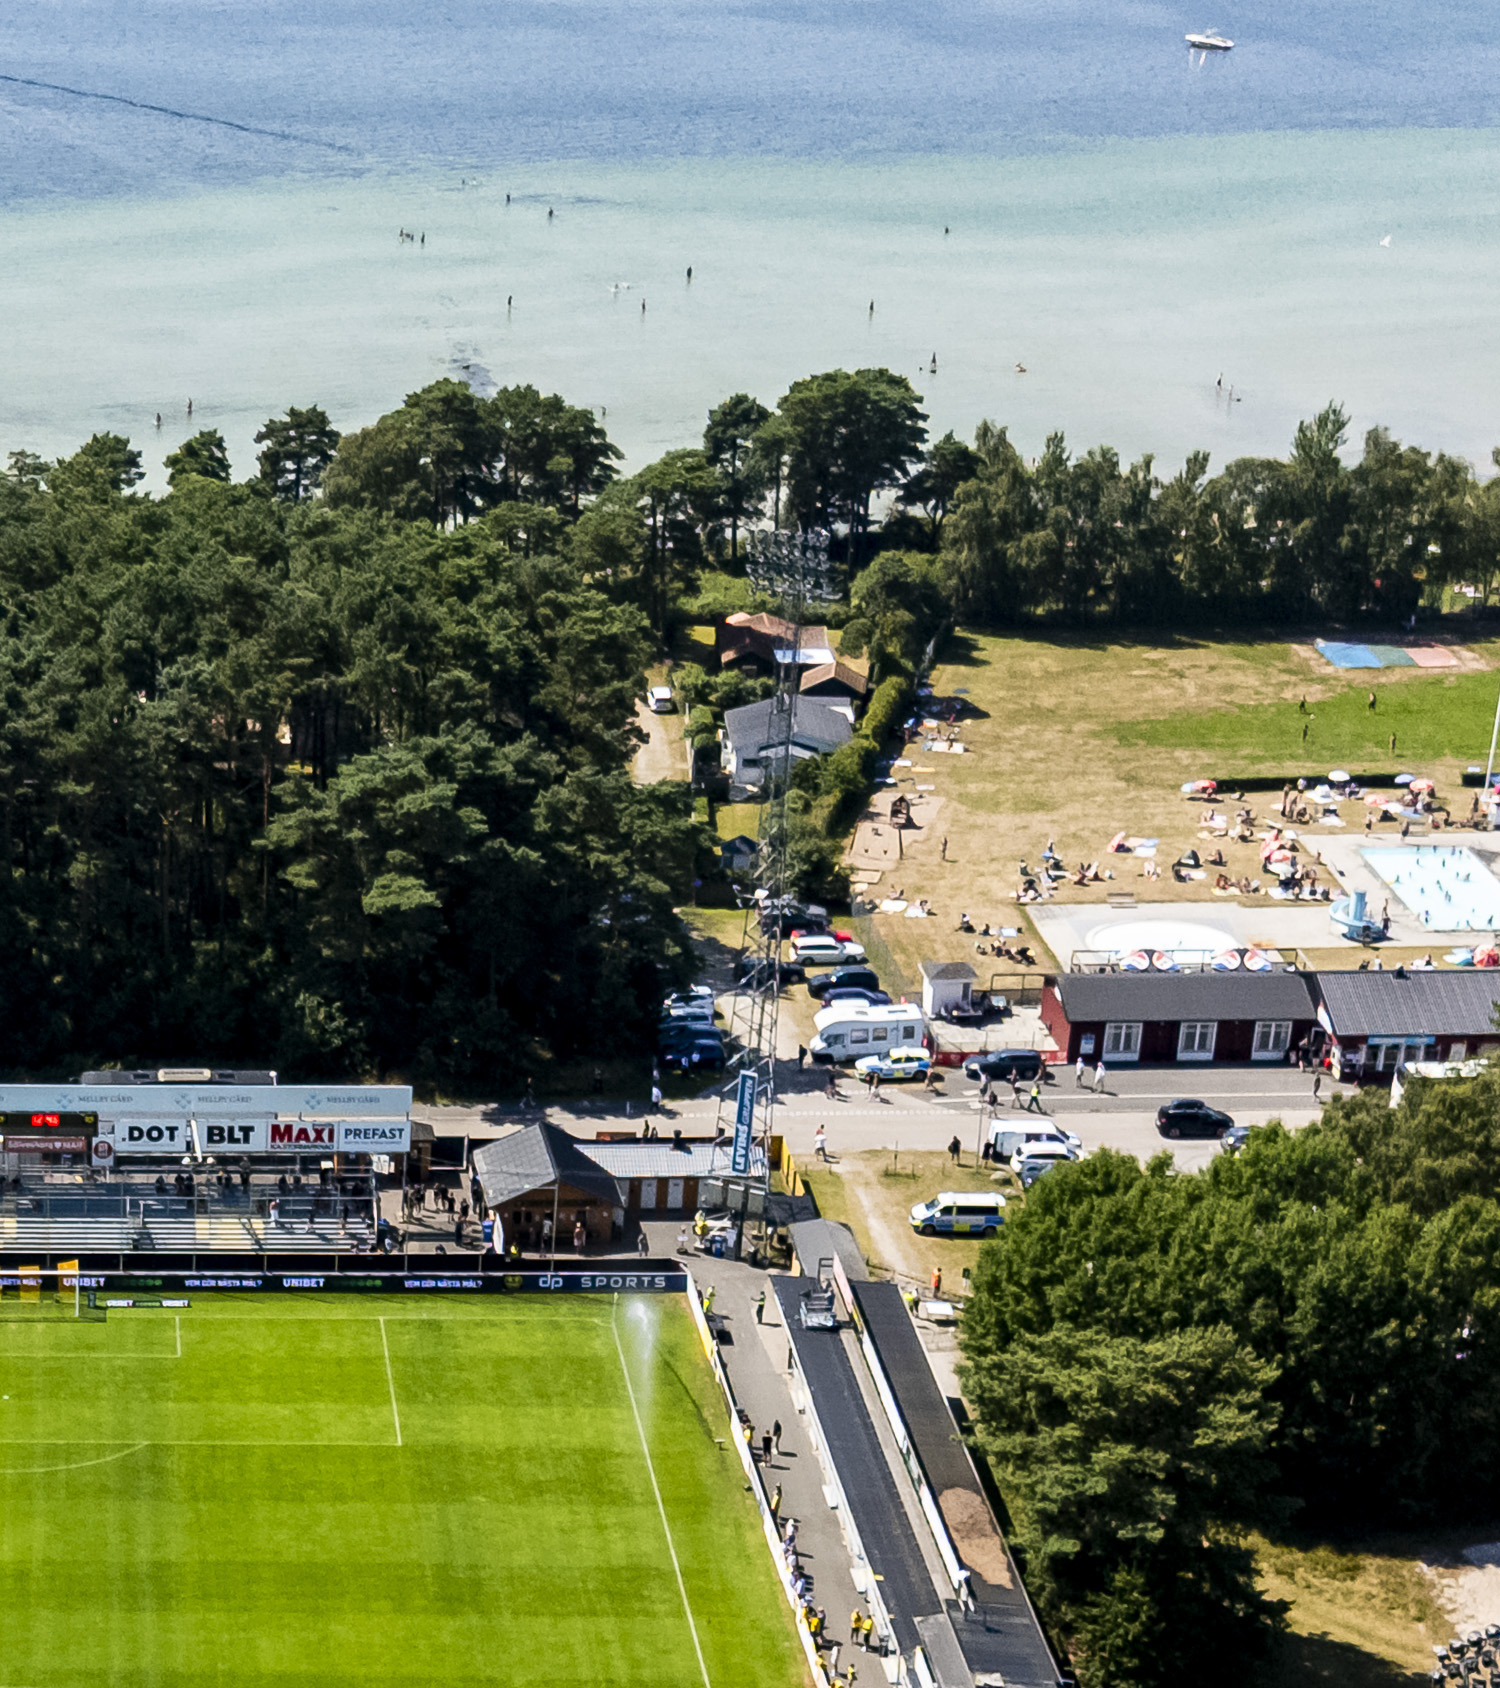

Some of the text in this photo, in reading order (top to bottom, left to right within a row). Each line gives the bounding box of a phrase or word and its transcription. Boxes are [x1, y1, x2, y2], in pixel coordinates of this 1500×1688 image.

[206, 1125, 255, 1144] BLT
[344, 1128, 405, 1140] PREFAST
[283, 1278, 325, 1287] UNIBET
[581, 1276, 666, 1288] SPORTS
